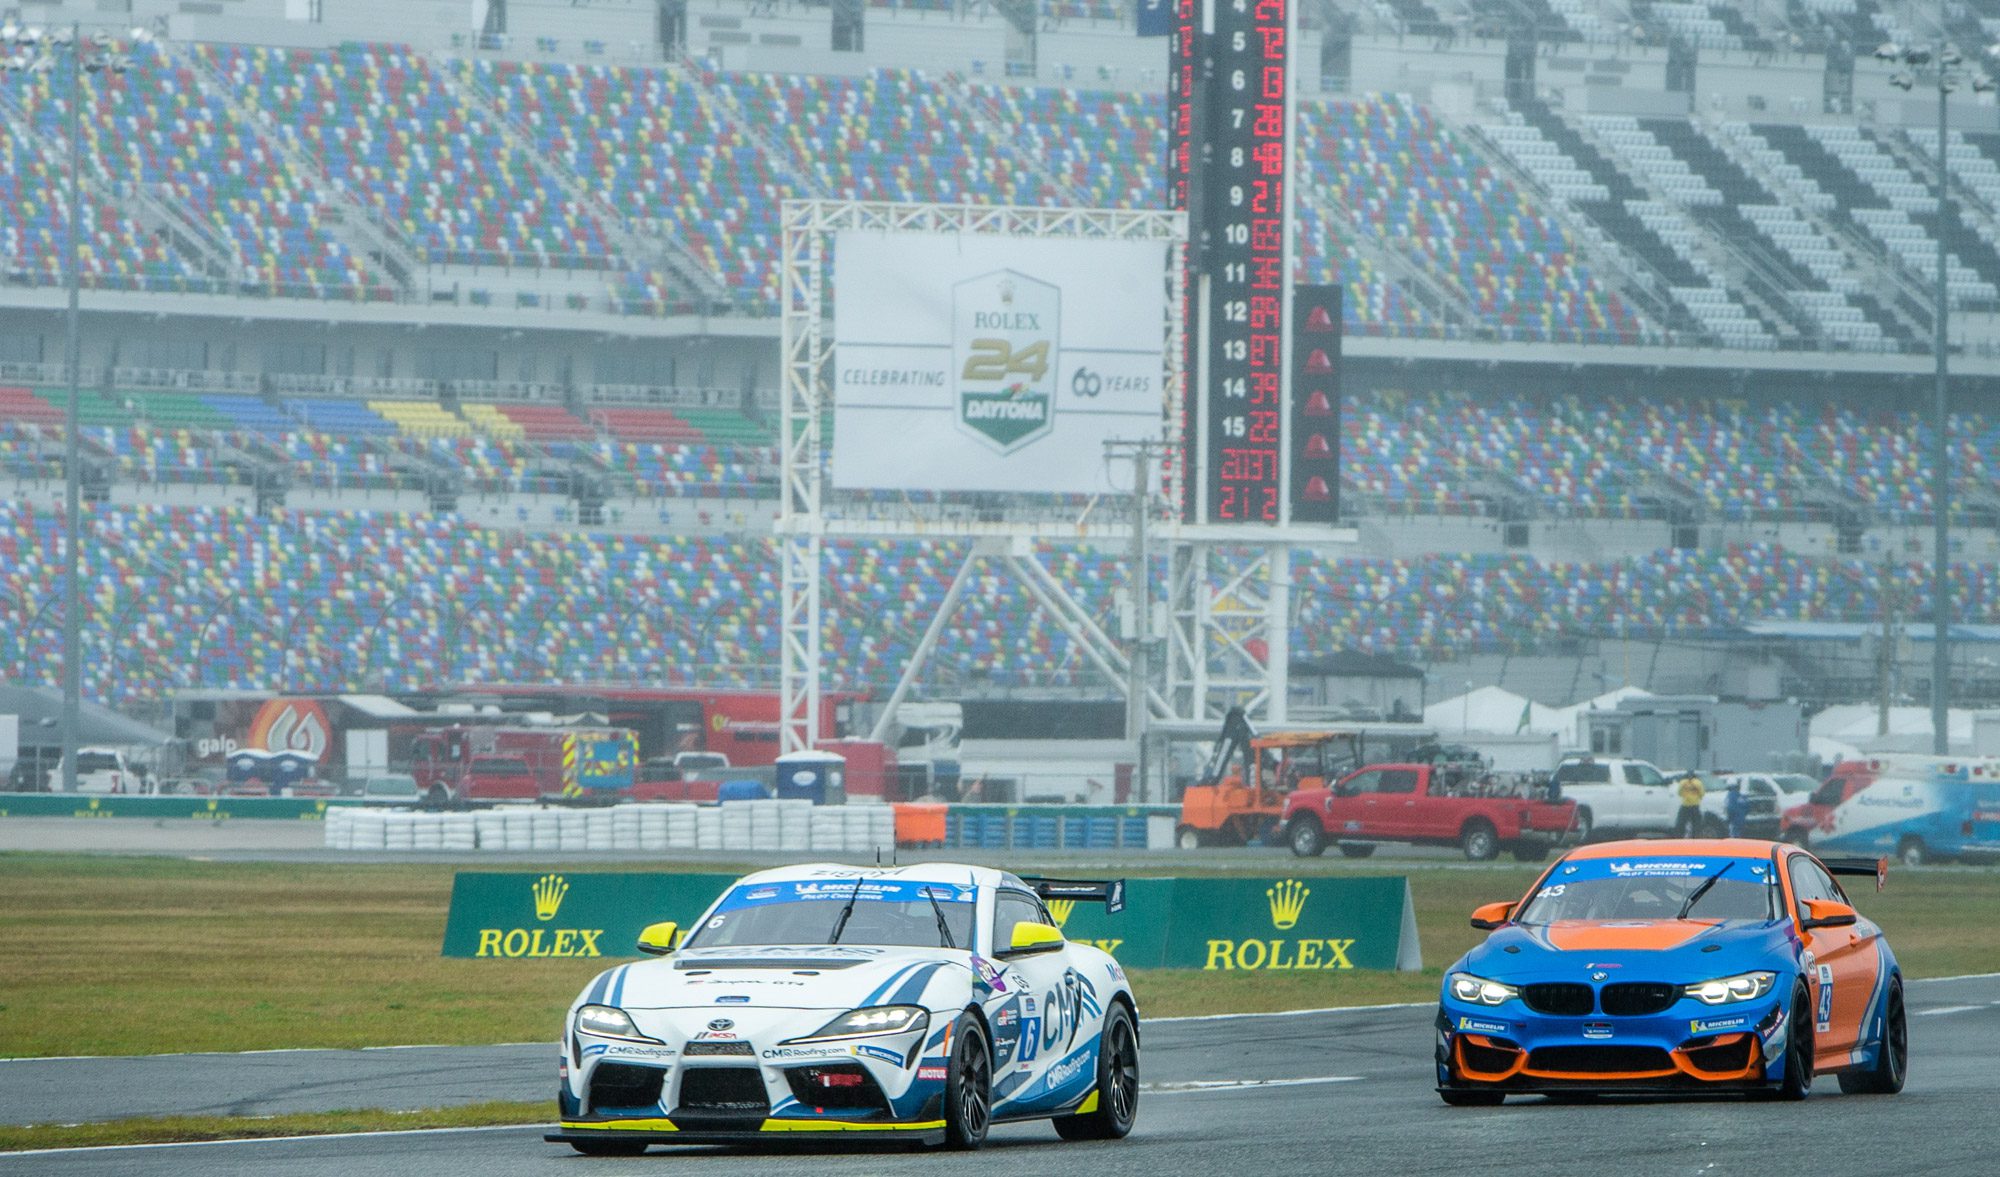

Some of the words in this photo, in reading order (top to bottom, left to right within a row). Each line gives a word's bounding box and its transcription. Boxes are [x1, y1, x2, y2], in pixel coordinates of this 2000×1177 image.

[1232, 31, 1246, 51] 5
[1231, 69, 1246, 91] 6
[1231, 108, 1245, 129] 7
[1230, 146, 1244, 168] 8
[1252, 142, 1283, 175] 48
[1230, 185, 1244, 207] 9
[1251, 180, 1282, 214] 21
[1225, 223, 1249, 244] 10
[1224, 262, 1246, 283] 11
[974, 311, 1041, 331] ROLEX
[1223, 299, 1247, 322] 12
[961, 338, 1051, 383] 24
[1222, 338, 1247, 361] 13
[843, 368, 945, 387] CELEBRATING
[1071, 366, 1101, 399] 60
[1105, 376, 1150, 393] YEARS
[1221, 377, 1247, 399] 14
[965, 400, 1043, 421] DAYTONA
[1221, 416, 1246, 438] 15
[198, 734, 238, 758] galp
[820, 884, 902, 893] MICHELIN
[1536, 884, 1566, 899] 43
[707, 914, 726, 929] 6
[475, 928, 604, 958] ROLEX
[1203, 938, 1356, 971] ROLEX
[1818, 985, 1832, 1022] 43
[1473, 1022, 1506, 1031] MICHELIN
[1707, 1018, 1745, 1029] MICHELIN
[1025, 1019, 1037, 1059] 6
[919, 1069, 947, 1079] MOTUL
